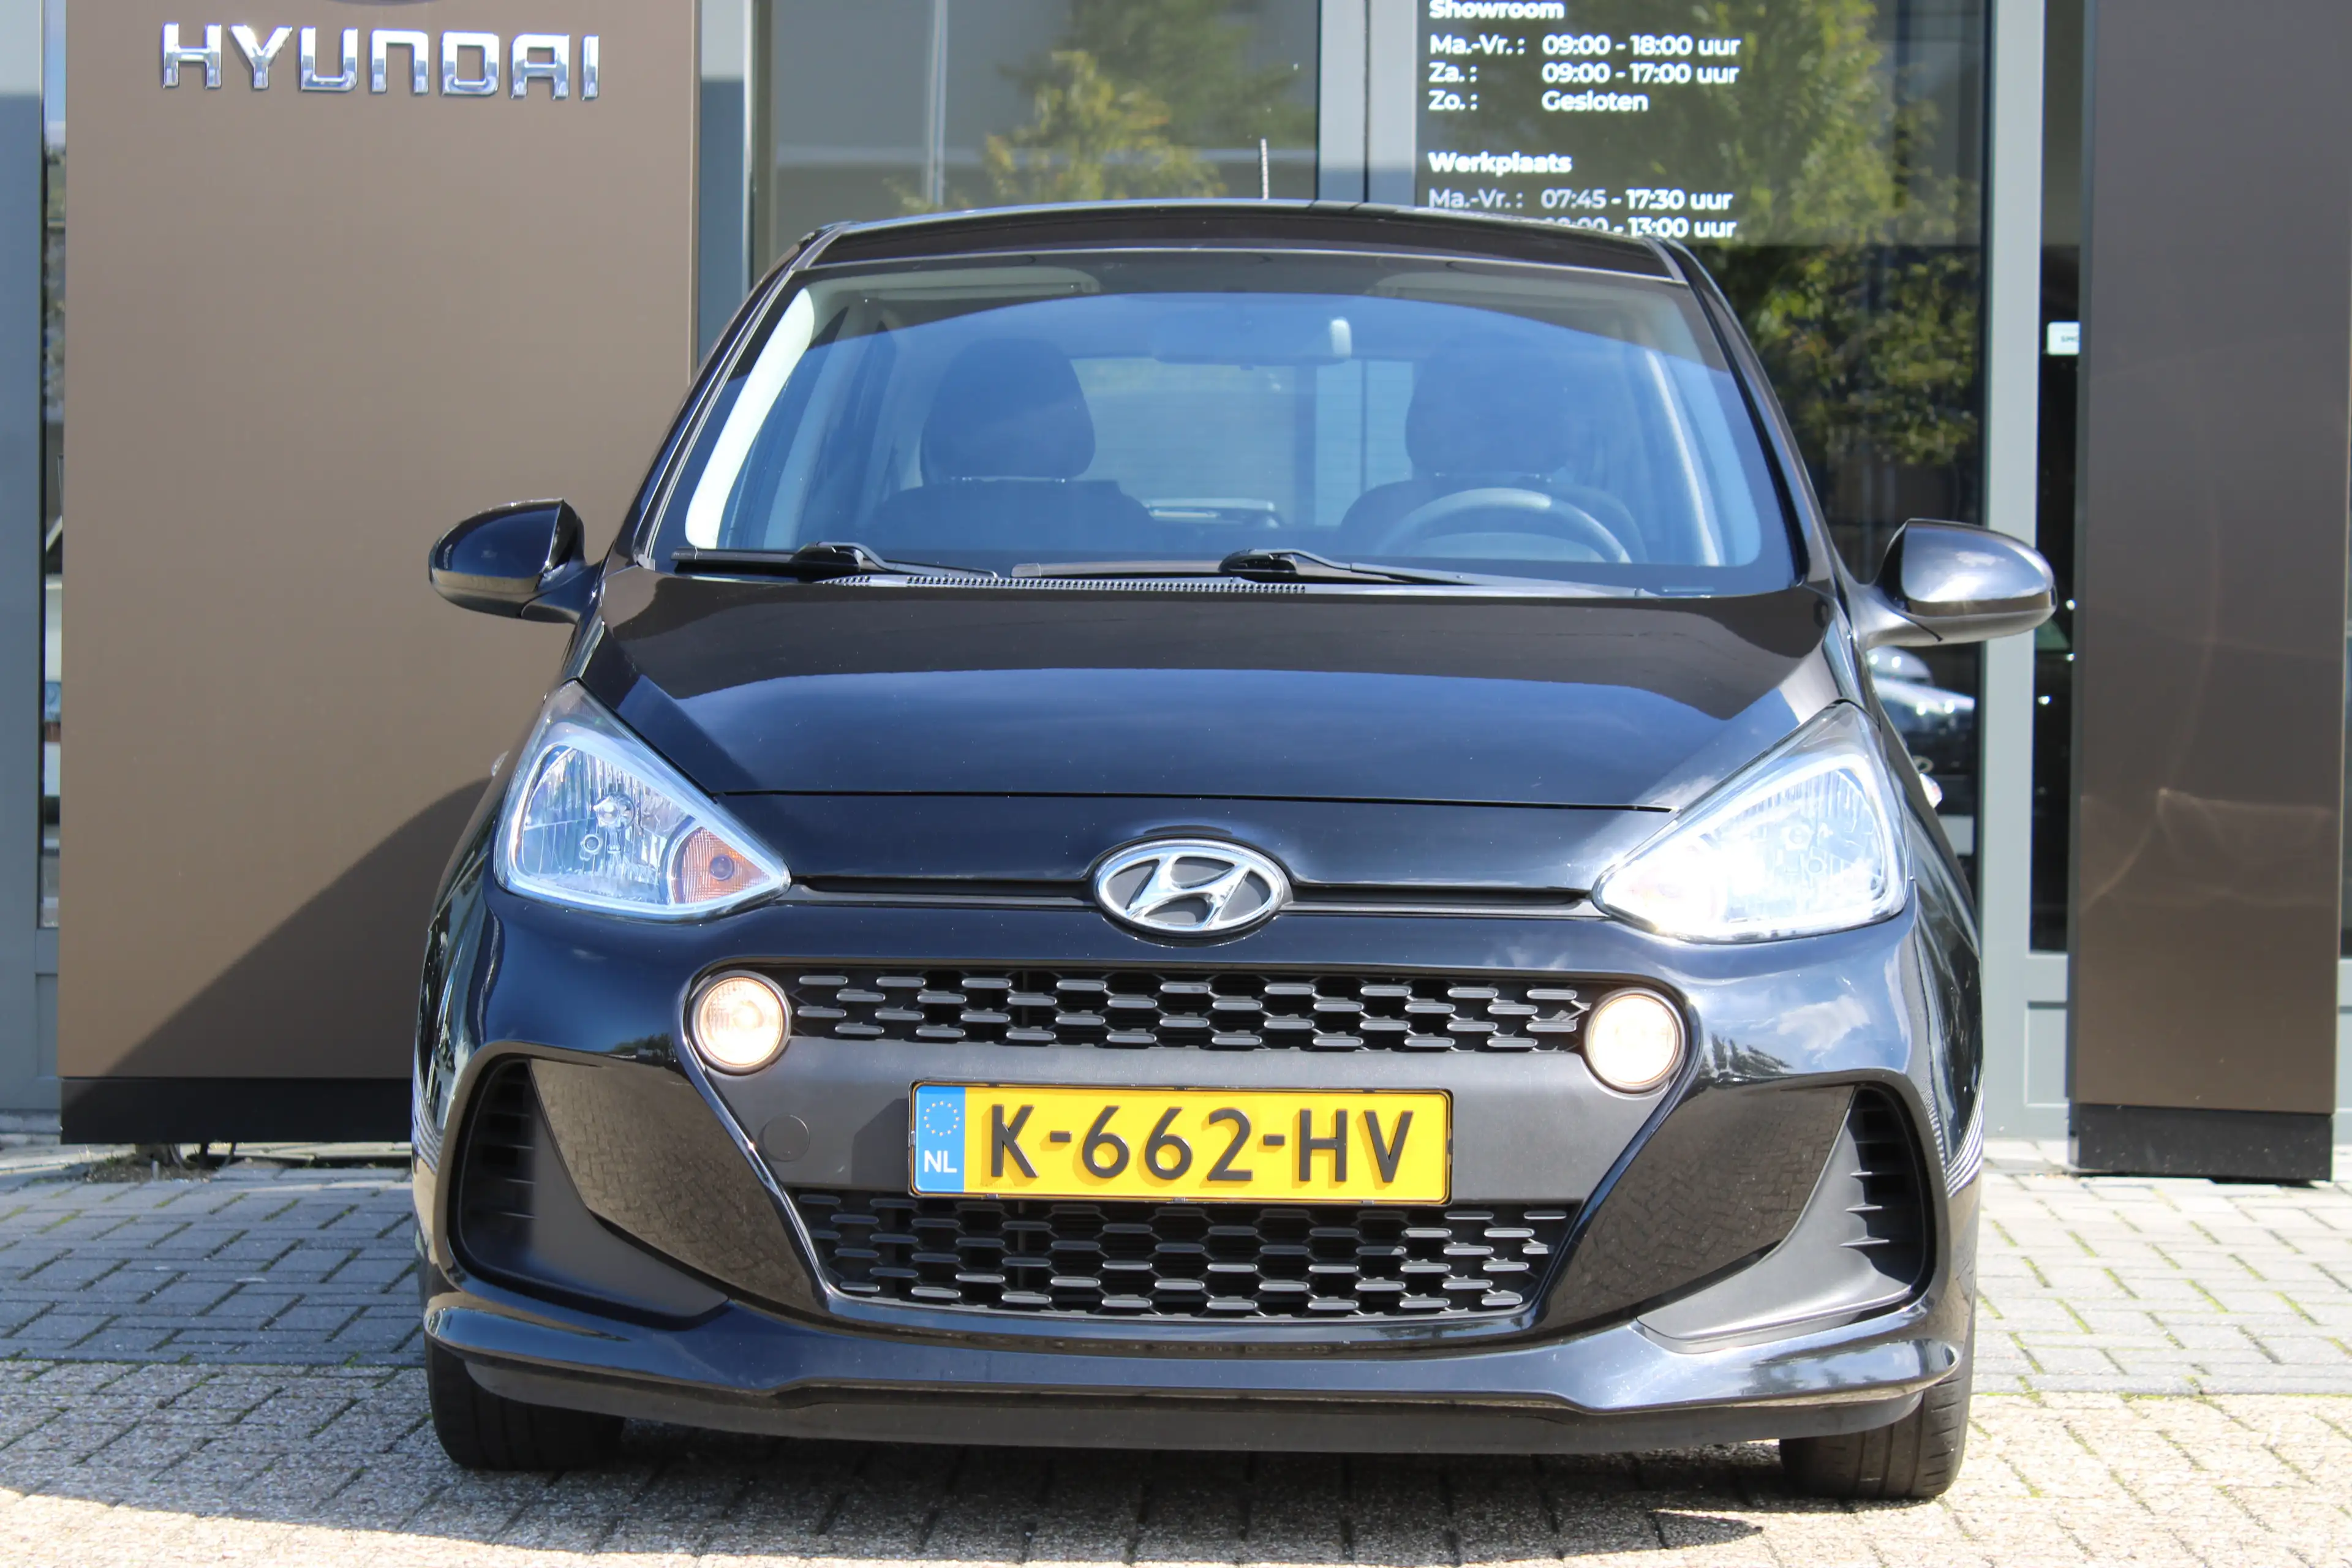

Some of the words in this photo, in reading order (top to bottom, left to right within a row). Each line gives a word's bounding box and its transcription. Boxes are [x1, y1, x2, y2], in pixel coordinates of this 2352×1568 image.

[1428, 0, 1565, 19] Showroom
[1542, 35, 1611, 55] 09:00
[1630, 35, 1693, 56] 18:00
[1698, 39, 1741, 56] uur
[162, 23, 600, 100] HYUNDAI
[1428, 62, 1465, 83] Za.
[1542, 62, 1611, 83] 09:00
[1629, 63, 1692, 84] 17:00
[1697, 67, 1740, 84] uur
[1428, 90, 1466, 110] Zo.
[1542, 90, 1648, 111] Gesloten
[1428, 151, 1572, 177] Werkplaats
[1541, 189, 1607, 209] 07:45
[1625, 189, 1685, 210] 17:30
[1691, 194, 1733, 210] uur
[1627, 217, 1689, 238] 13:00
[1694, 222, 1737, 238] uur
[924, 1150, 957, 1174] NL
[990, 1104, 1414, 1184] K-662-HV
